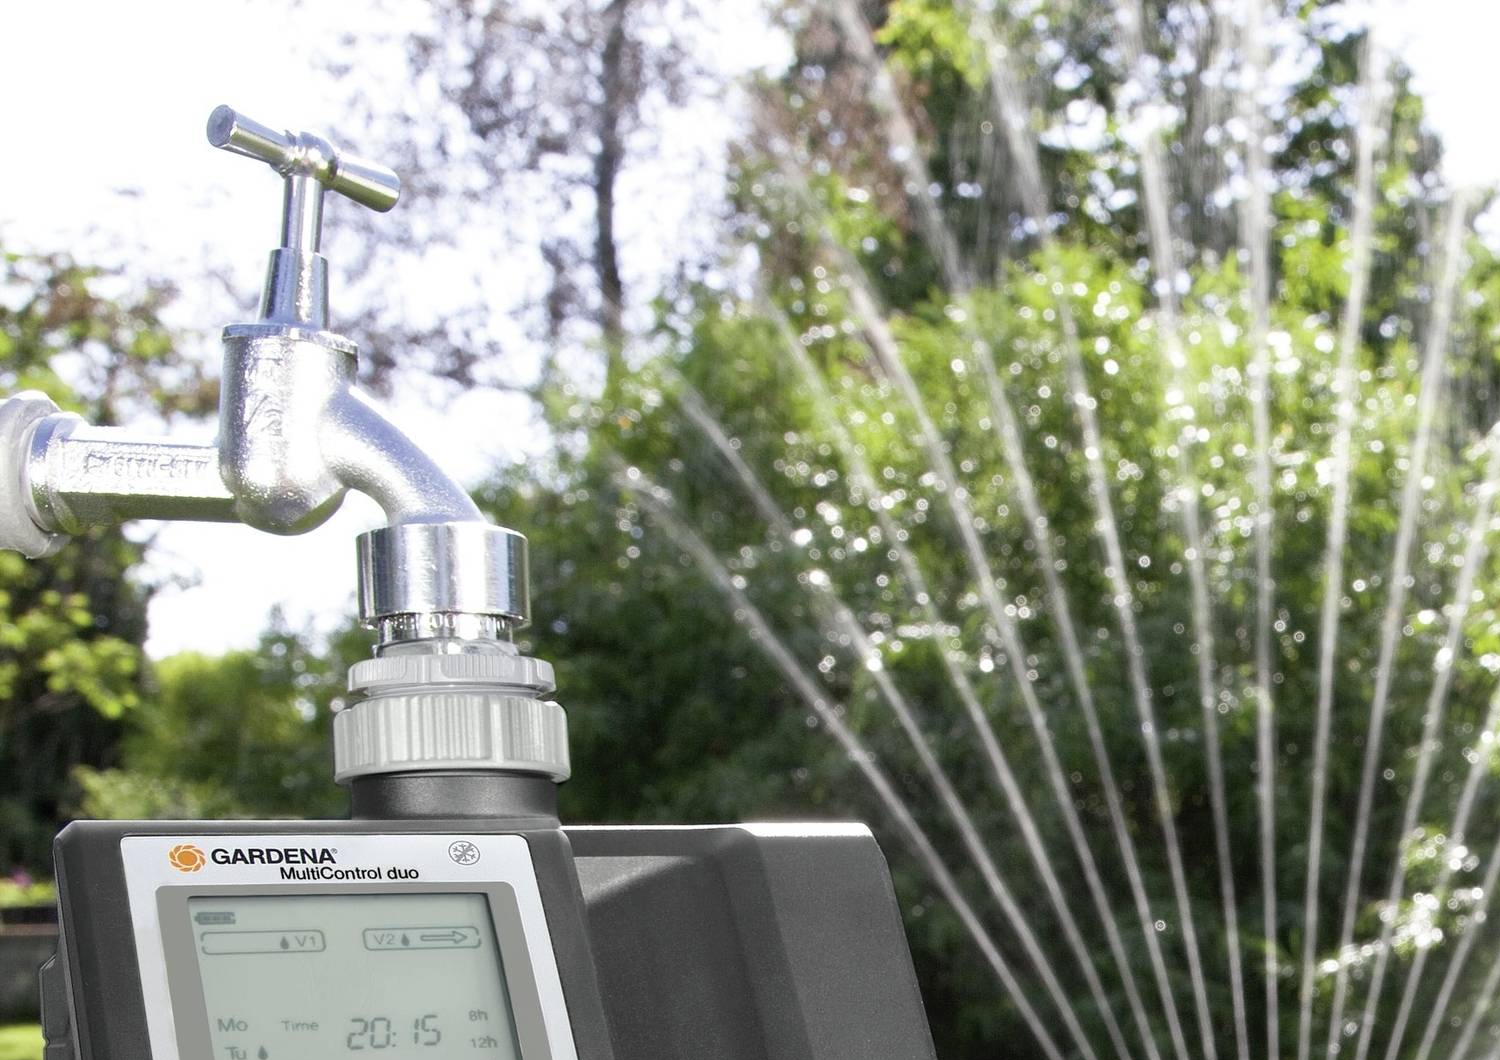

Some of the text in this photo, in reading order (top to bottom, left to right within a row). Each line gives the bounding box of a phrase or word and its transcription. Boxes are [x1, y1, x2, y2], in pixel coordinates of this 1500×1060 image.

[280, 866, 419, 880] MultiControl duo
[295, 936, 317, 948] V1
[373, 932, 396, 945] V2
[217, 1018, 248, 1032] Mo
[281, 1020, 319, 1032] Time
[470, 1035, 498, 1048] 12h
[225, 1046, 247, 1060] Tu
